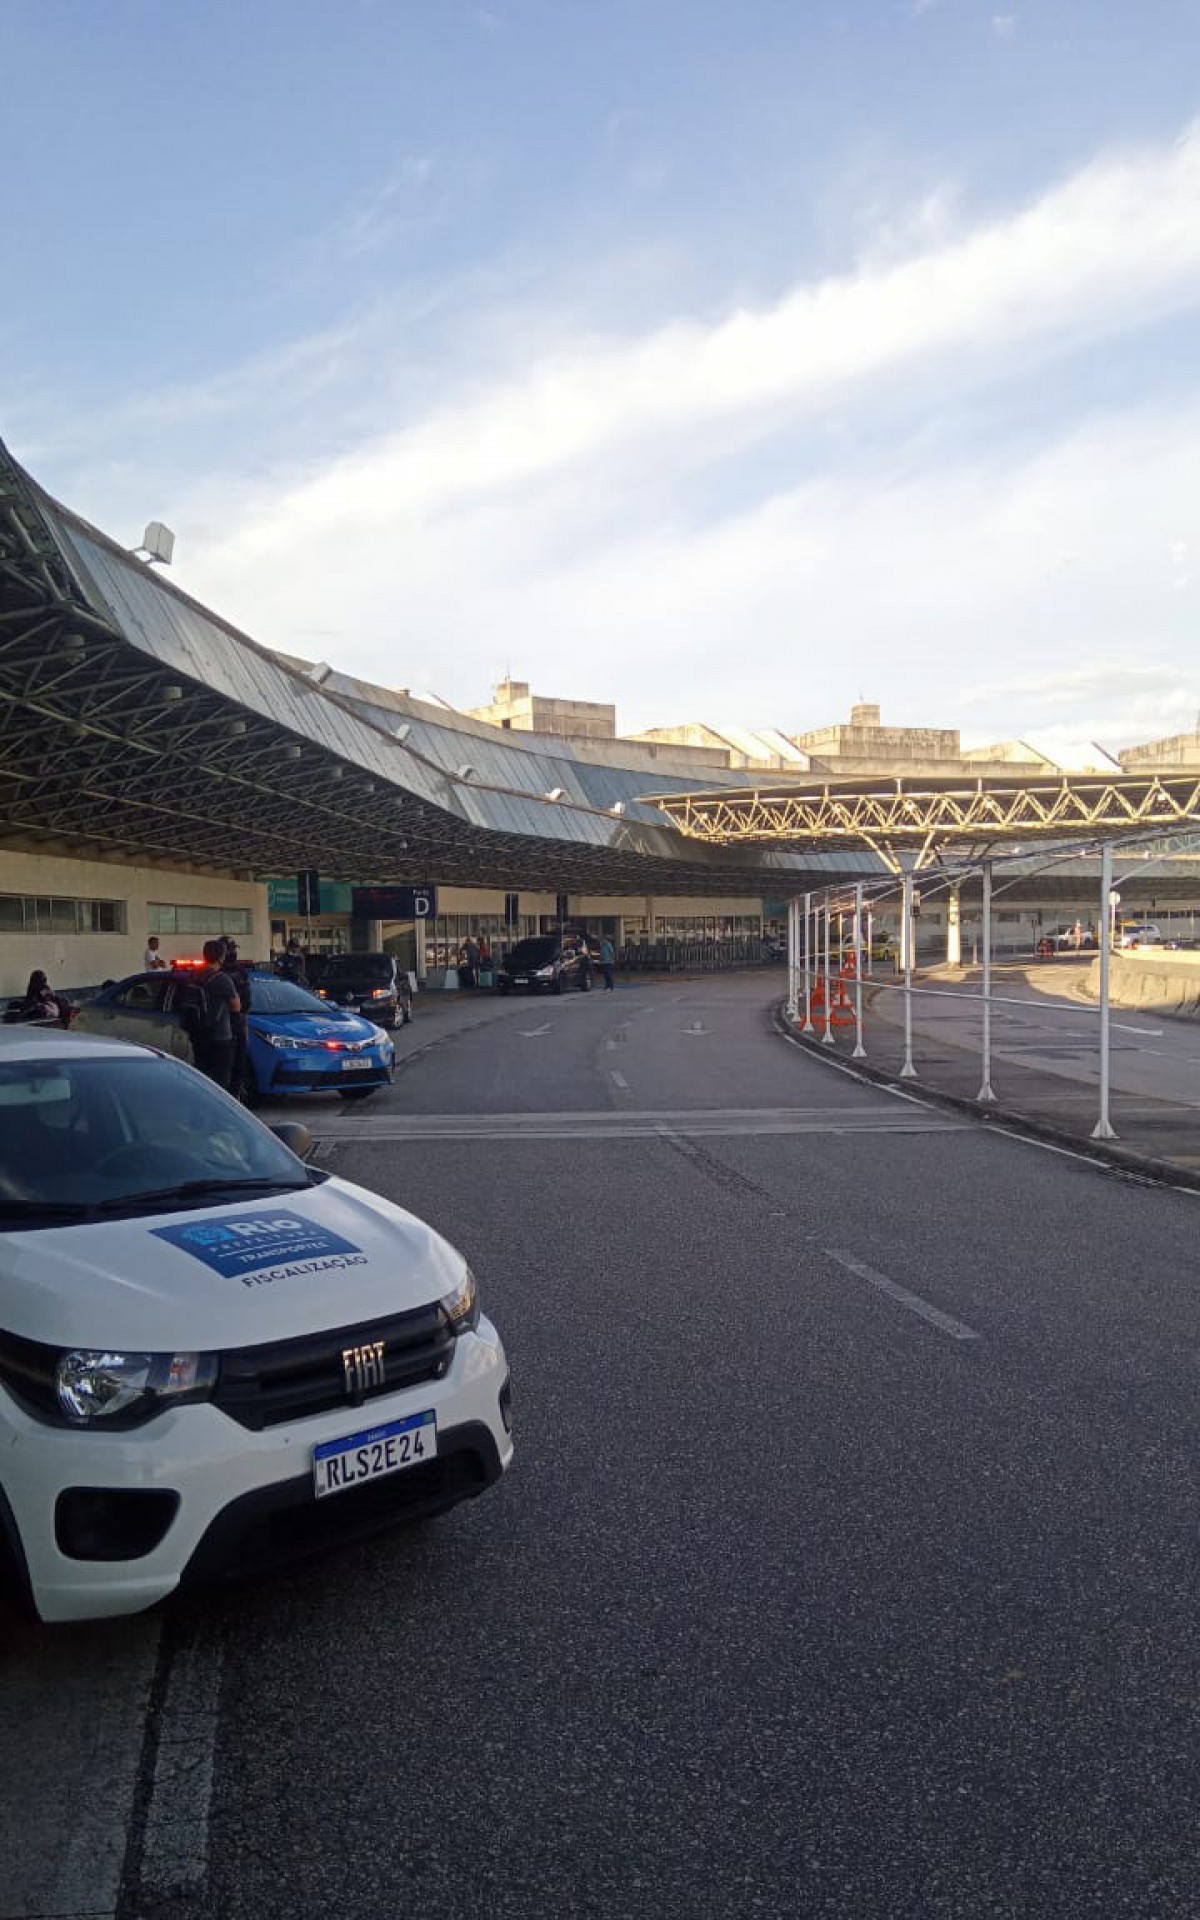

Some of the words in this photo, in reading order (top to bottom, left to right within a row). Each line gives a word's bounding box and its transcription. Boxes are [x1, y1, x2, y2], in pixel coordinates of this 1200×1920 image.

[414, 897, 430, 916] D
[224, 1219, 302, 1236] Rio
[241, 1256, 368, 1288] FISCALIZAÇÃO
[342, 1341, 386, 1393] FIAT
[326, 1430, 424, 1489] RLS2E24
